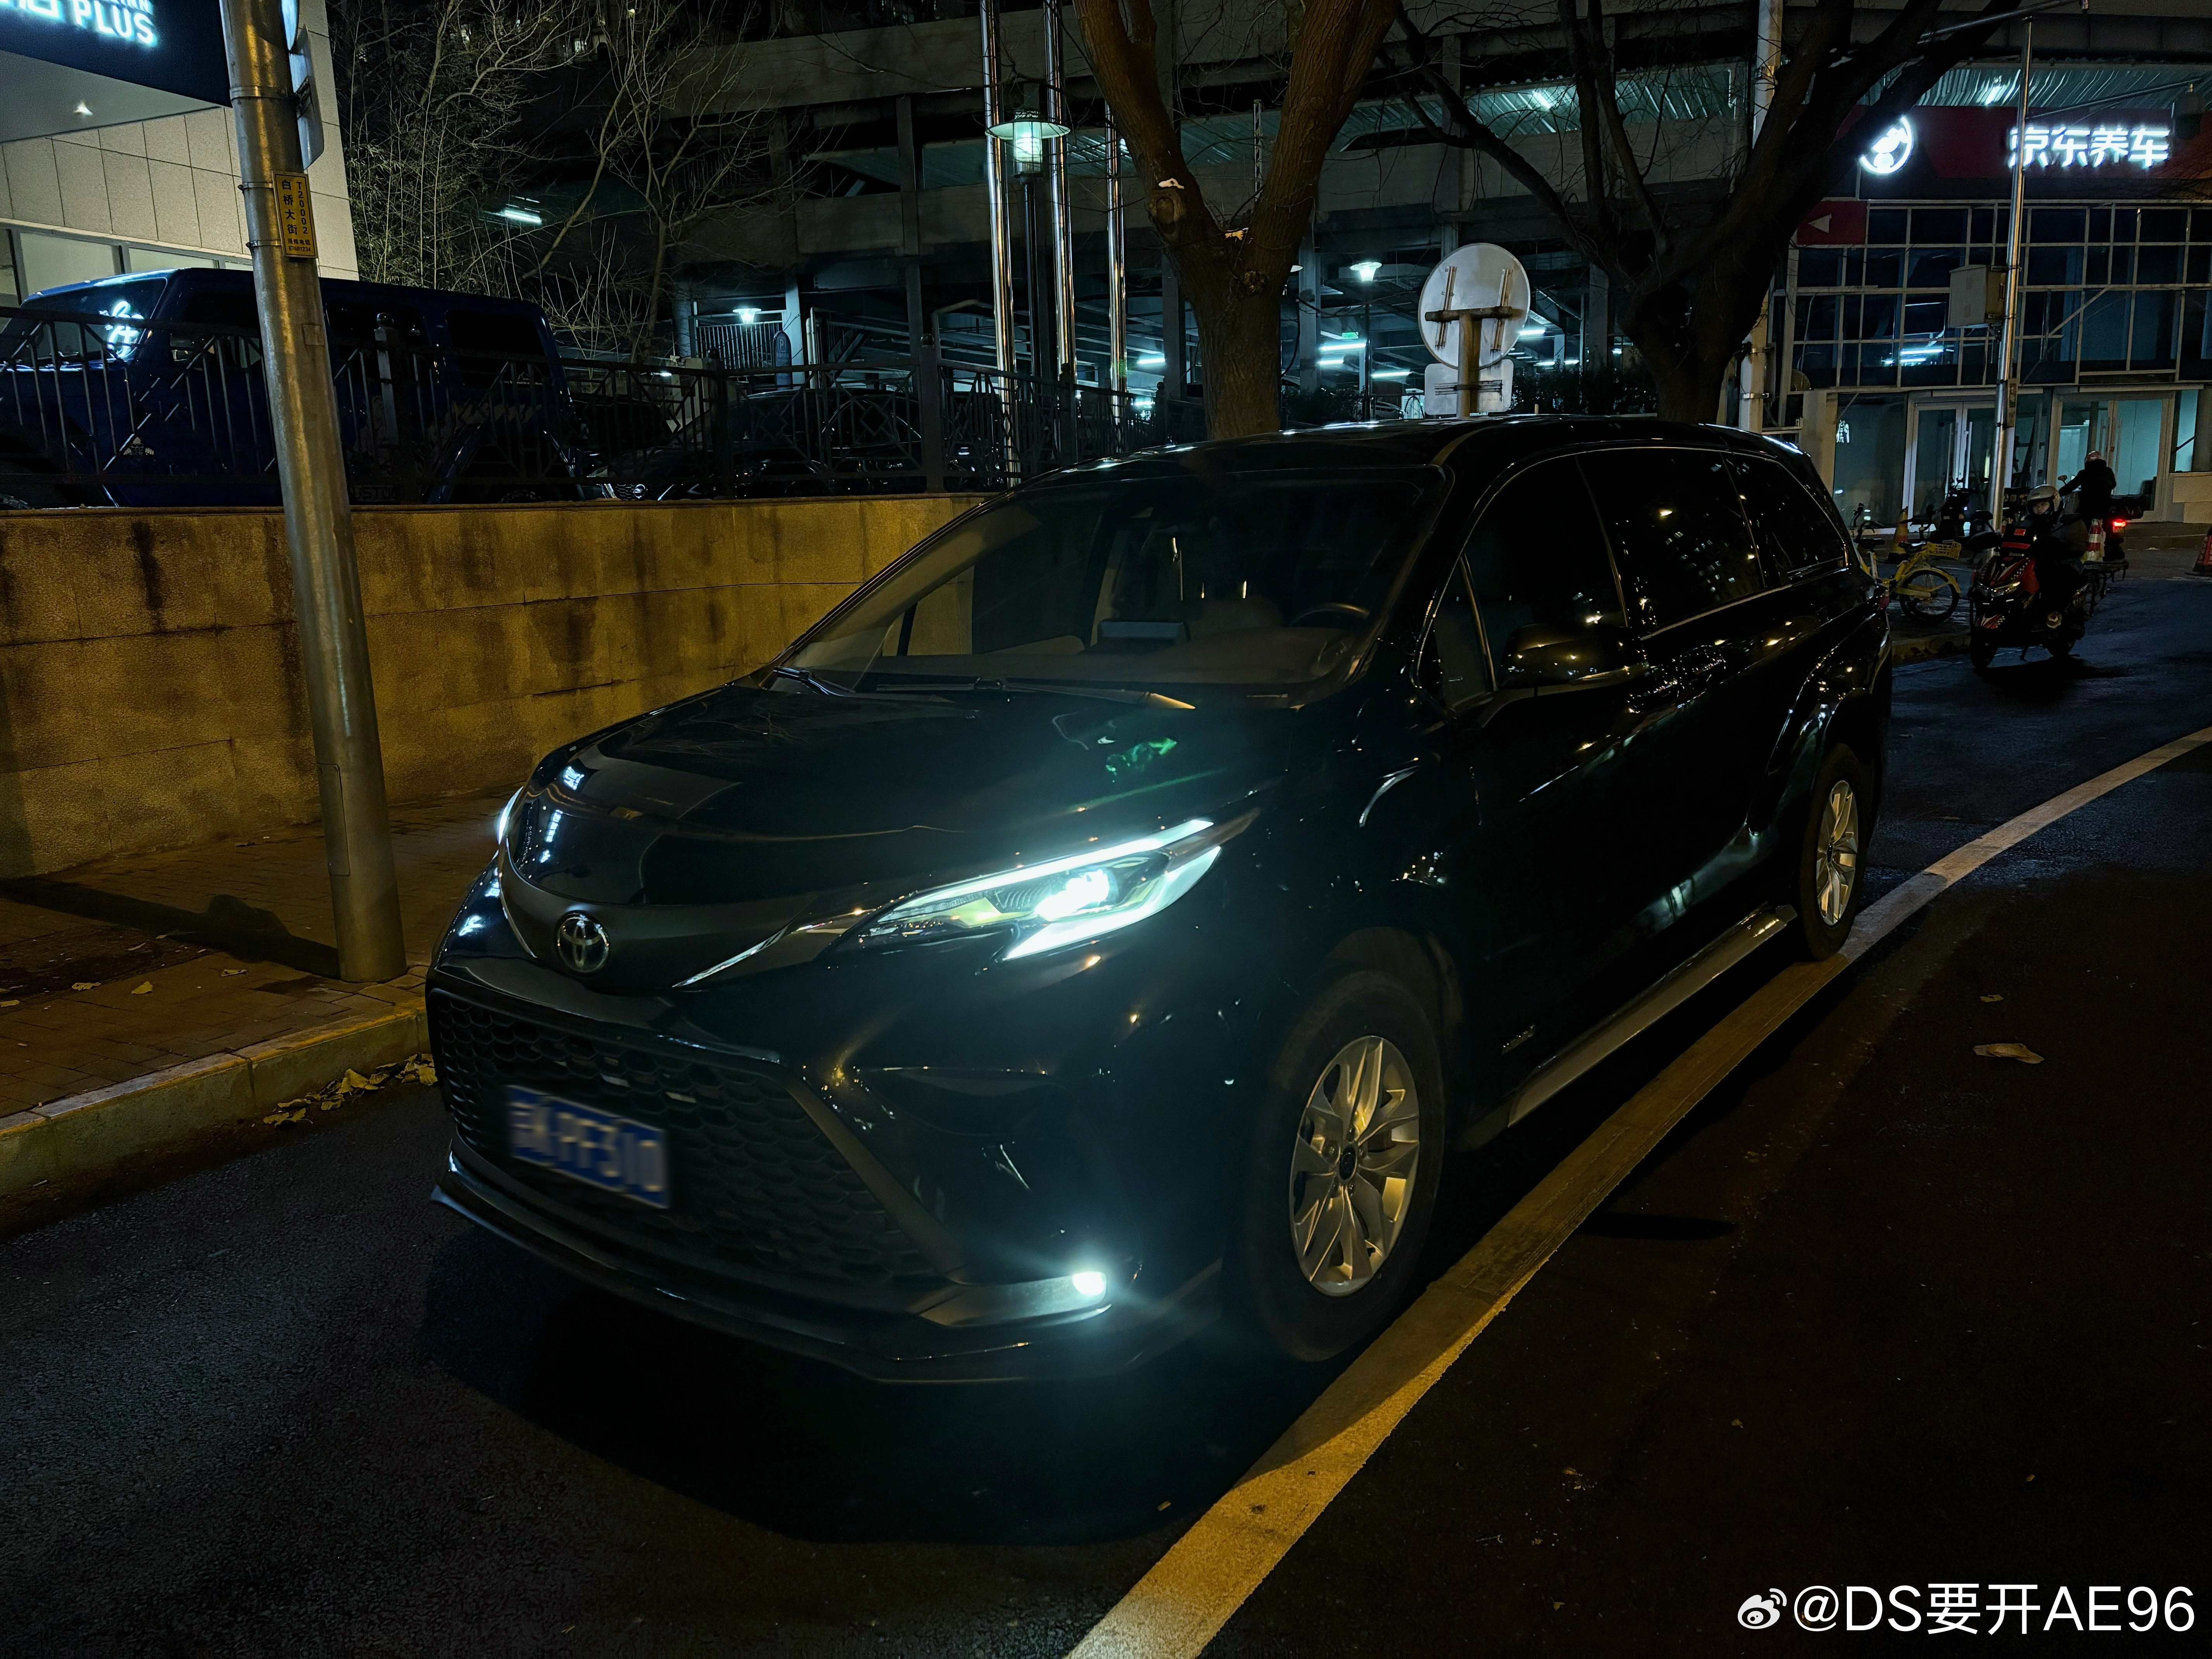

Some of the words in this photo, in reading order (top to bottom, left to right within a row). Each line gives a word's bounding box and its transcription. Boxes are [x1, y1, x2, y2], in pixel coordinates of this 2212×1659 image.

[72, 0, 156, 45] PLUS
[2009, 127, 2169, 168] 京东养车
[282, 180, 297, 235] 白桥大街
[296, 182, 308, 234] T20002
